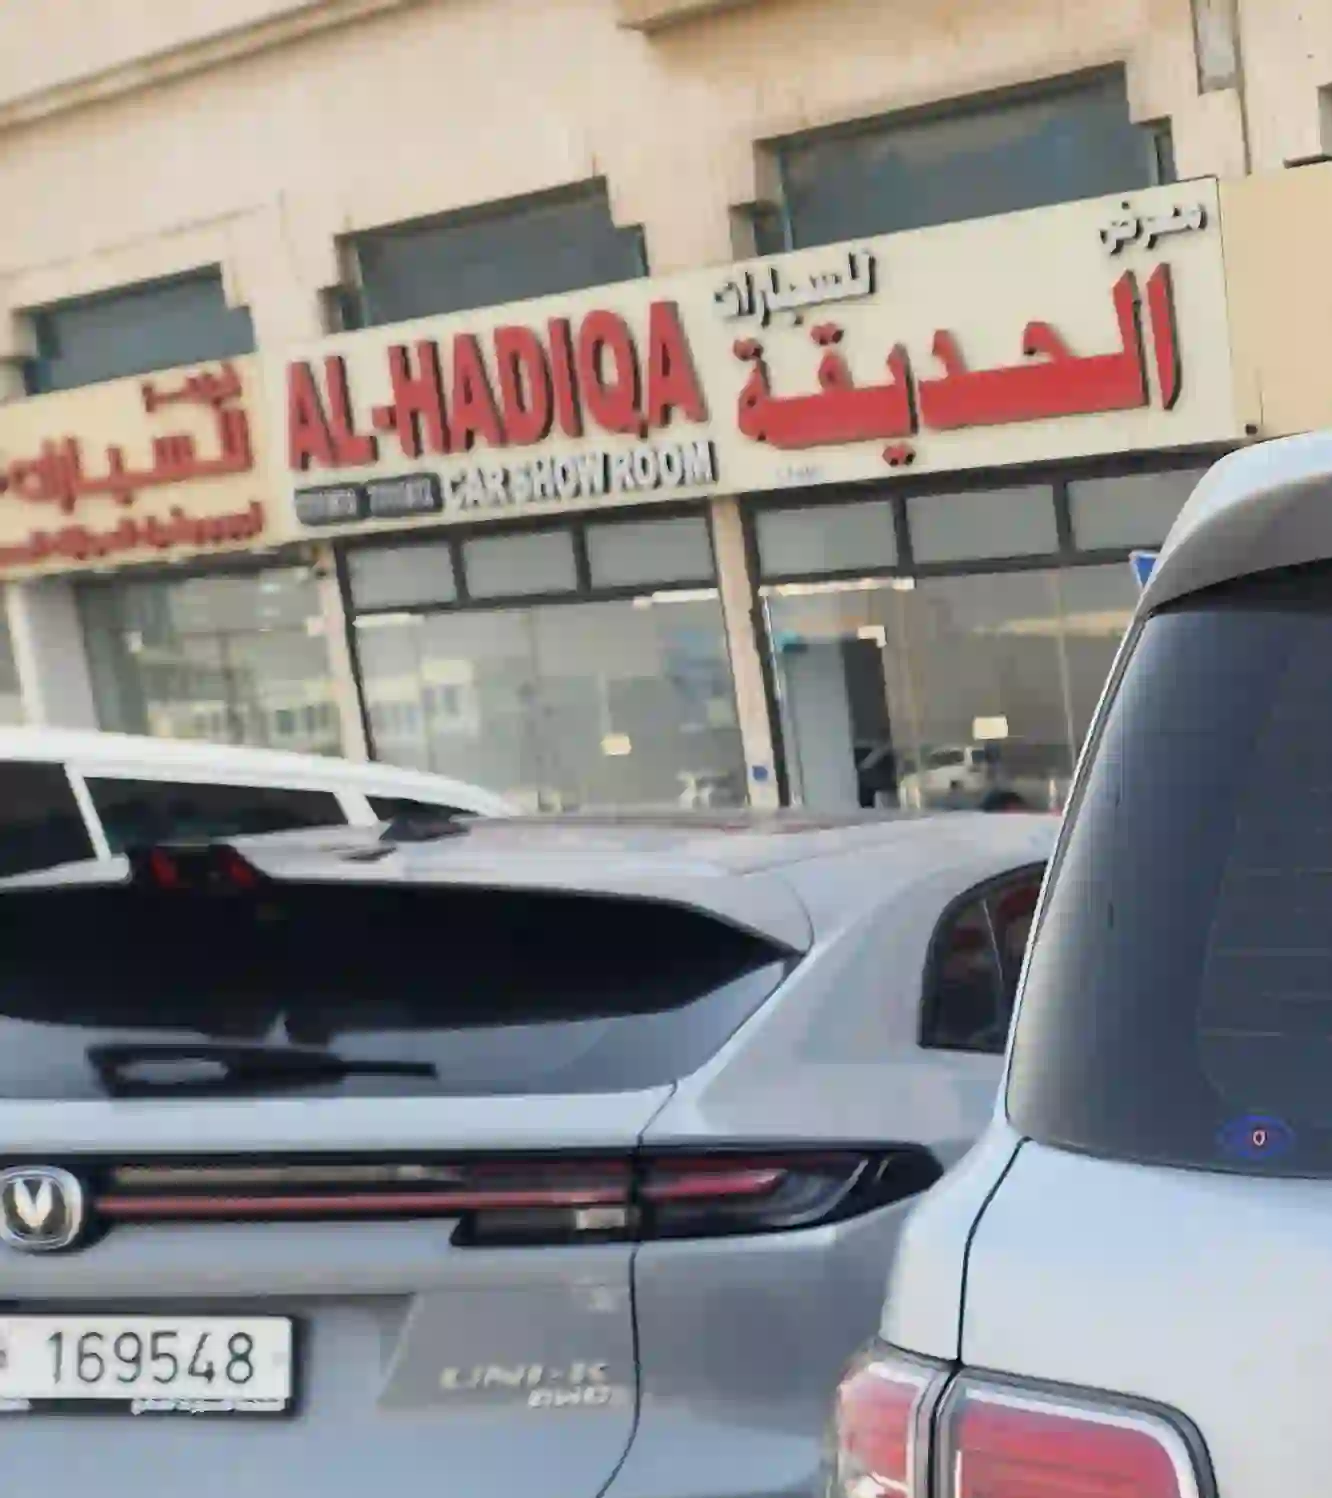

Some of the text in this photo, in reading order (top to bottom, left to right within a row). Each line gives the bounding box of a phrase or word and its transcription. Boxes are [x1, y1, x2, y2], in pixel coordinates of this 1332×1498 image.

[287, 300, 708, 471] AL-HADIQA
[733, 262, 1183, 468] الحديقة
[443, 460, 506, 514] CAR
[46, 1330, 254, 1385] 169548
